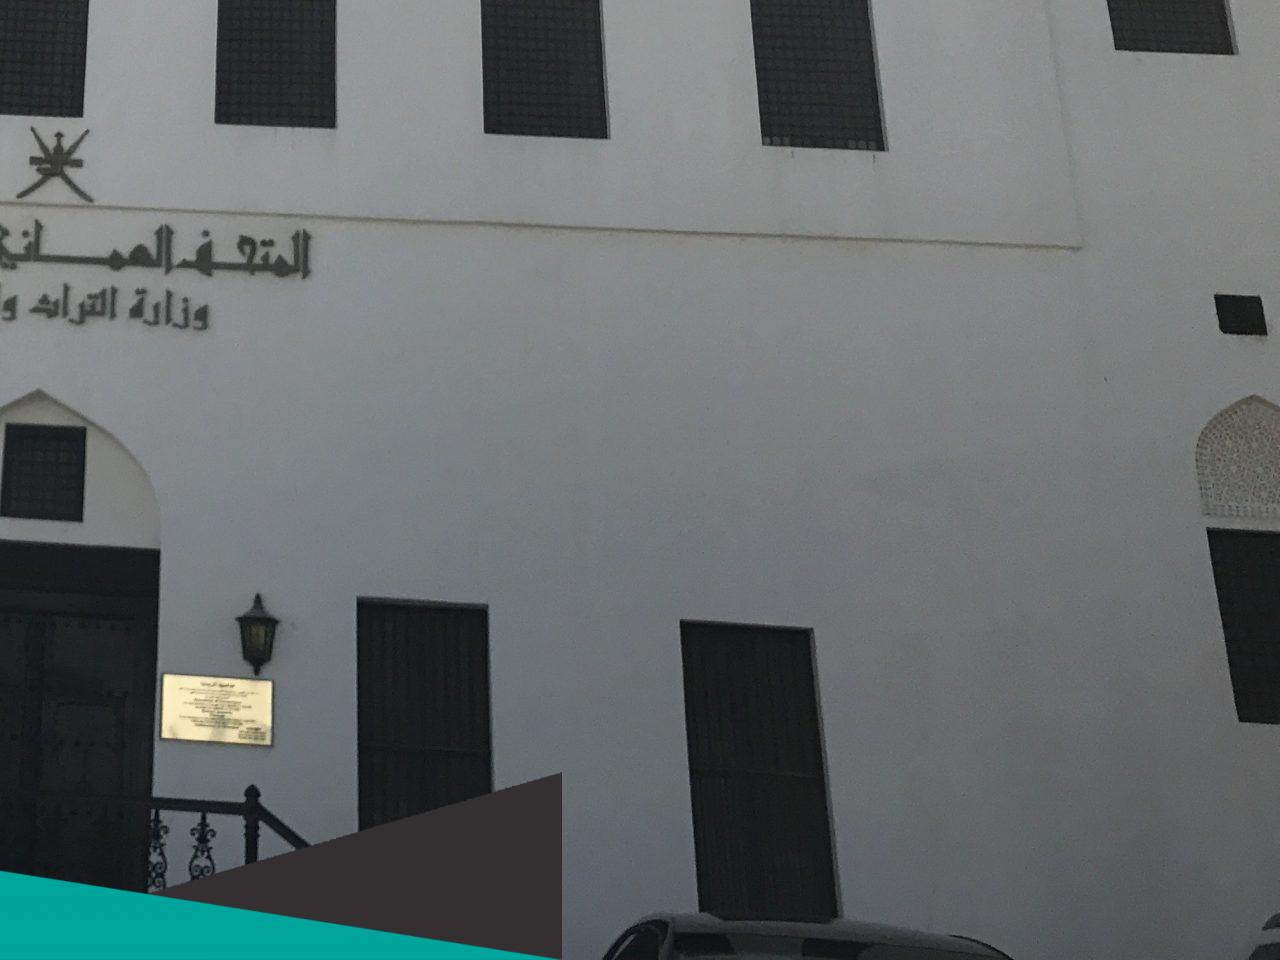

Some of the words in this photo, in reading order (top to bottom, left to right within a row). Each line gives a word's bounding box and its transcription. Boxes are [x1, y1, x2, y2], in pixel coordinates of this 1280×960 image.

[175, 228, 313, 280] المتحف
[28, 282, 119, 327] التراث
[128, 287, 210, 332] وزارة
